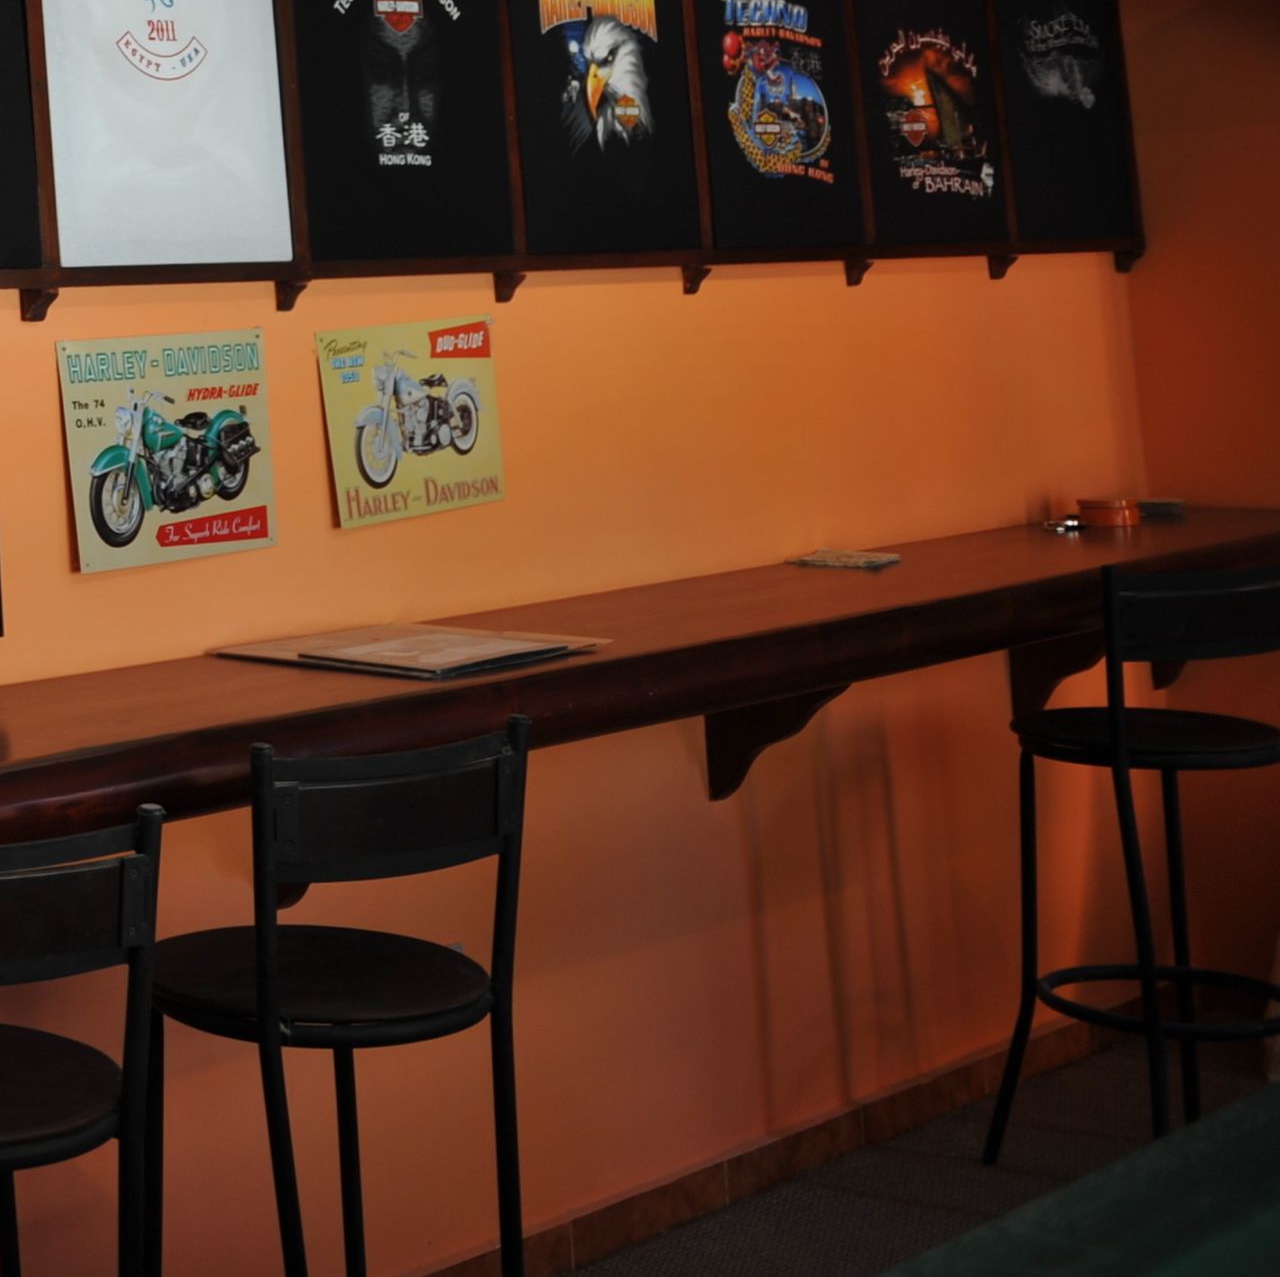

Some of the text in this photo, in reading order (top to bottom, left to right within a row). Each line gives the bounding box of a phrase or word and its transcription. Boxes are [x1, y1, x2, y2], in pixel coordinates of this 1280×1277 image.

[146, 20, 178, 42] 2011
[179, 47, 201, 68] USA
[376, 123, 430, 147] 香港
[379, 154, 432, 167] HONG KONG
[924, 177, 984, 197] BAHRAIN
[436, 330, 485, 353] DUO-GLIDE
[187, 383, 260, 402] HYDRA-GLIDE
[72, 399, 106, 410] The 74
